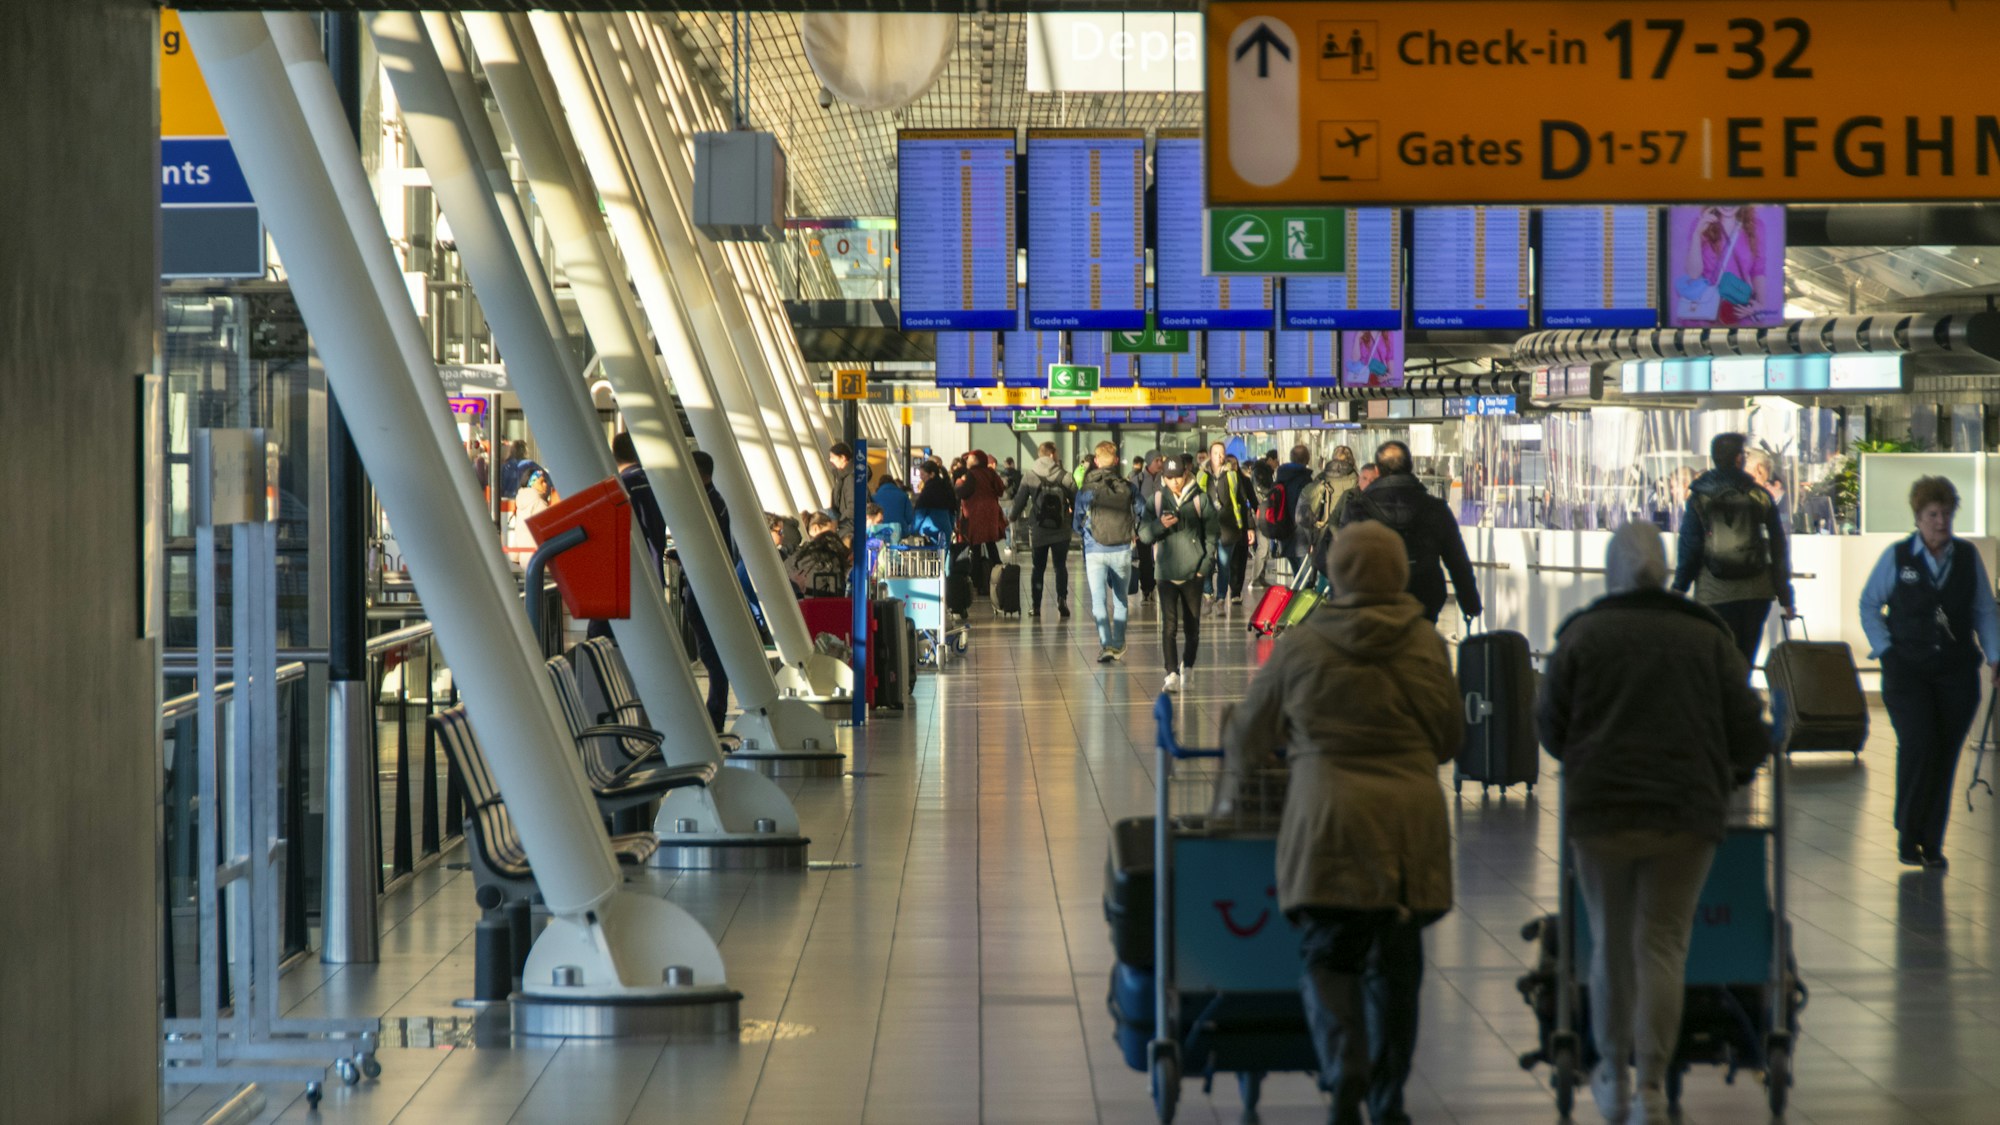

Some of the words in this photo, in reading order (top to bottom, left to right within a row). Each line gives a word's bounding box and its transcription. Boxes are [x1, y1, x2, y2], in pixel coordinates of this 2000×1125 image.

[1397, 28, 1588, 66] Check-in
[1603, 17, 1813, 80] 17-32
[1397, 128, 1523, 167] Gates
[906, 317, 933, 326] Goede
[935, 317, 951, 326] reis
[1033, 317, 1060, 326] Goede
[1063, 317, 1079, 326] reis
[1163, 316, 1190, 325] Goede
[1192, 316, 1208, 325] reis
[1290, 316, 1317, 325] Goede
[1319, 316, 1335, 325] reis
[1418, 316, 1445, 325] Goede
[1447, 316, 1463, 325] reis
[1547, 316, 1574, 325] Goede
[1576, 316, 1592, 325] reis
[438, 369, 493, 381] epartures
[1006, 389, 1027, 398] Trains
[1250, 387, 1272, 397] Gates
[1274, 387, 1286, 399] M
[912, 602, 927, 610] TUI
